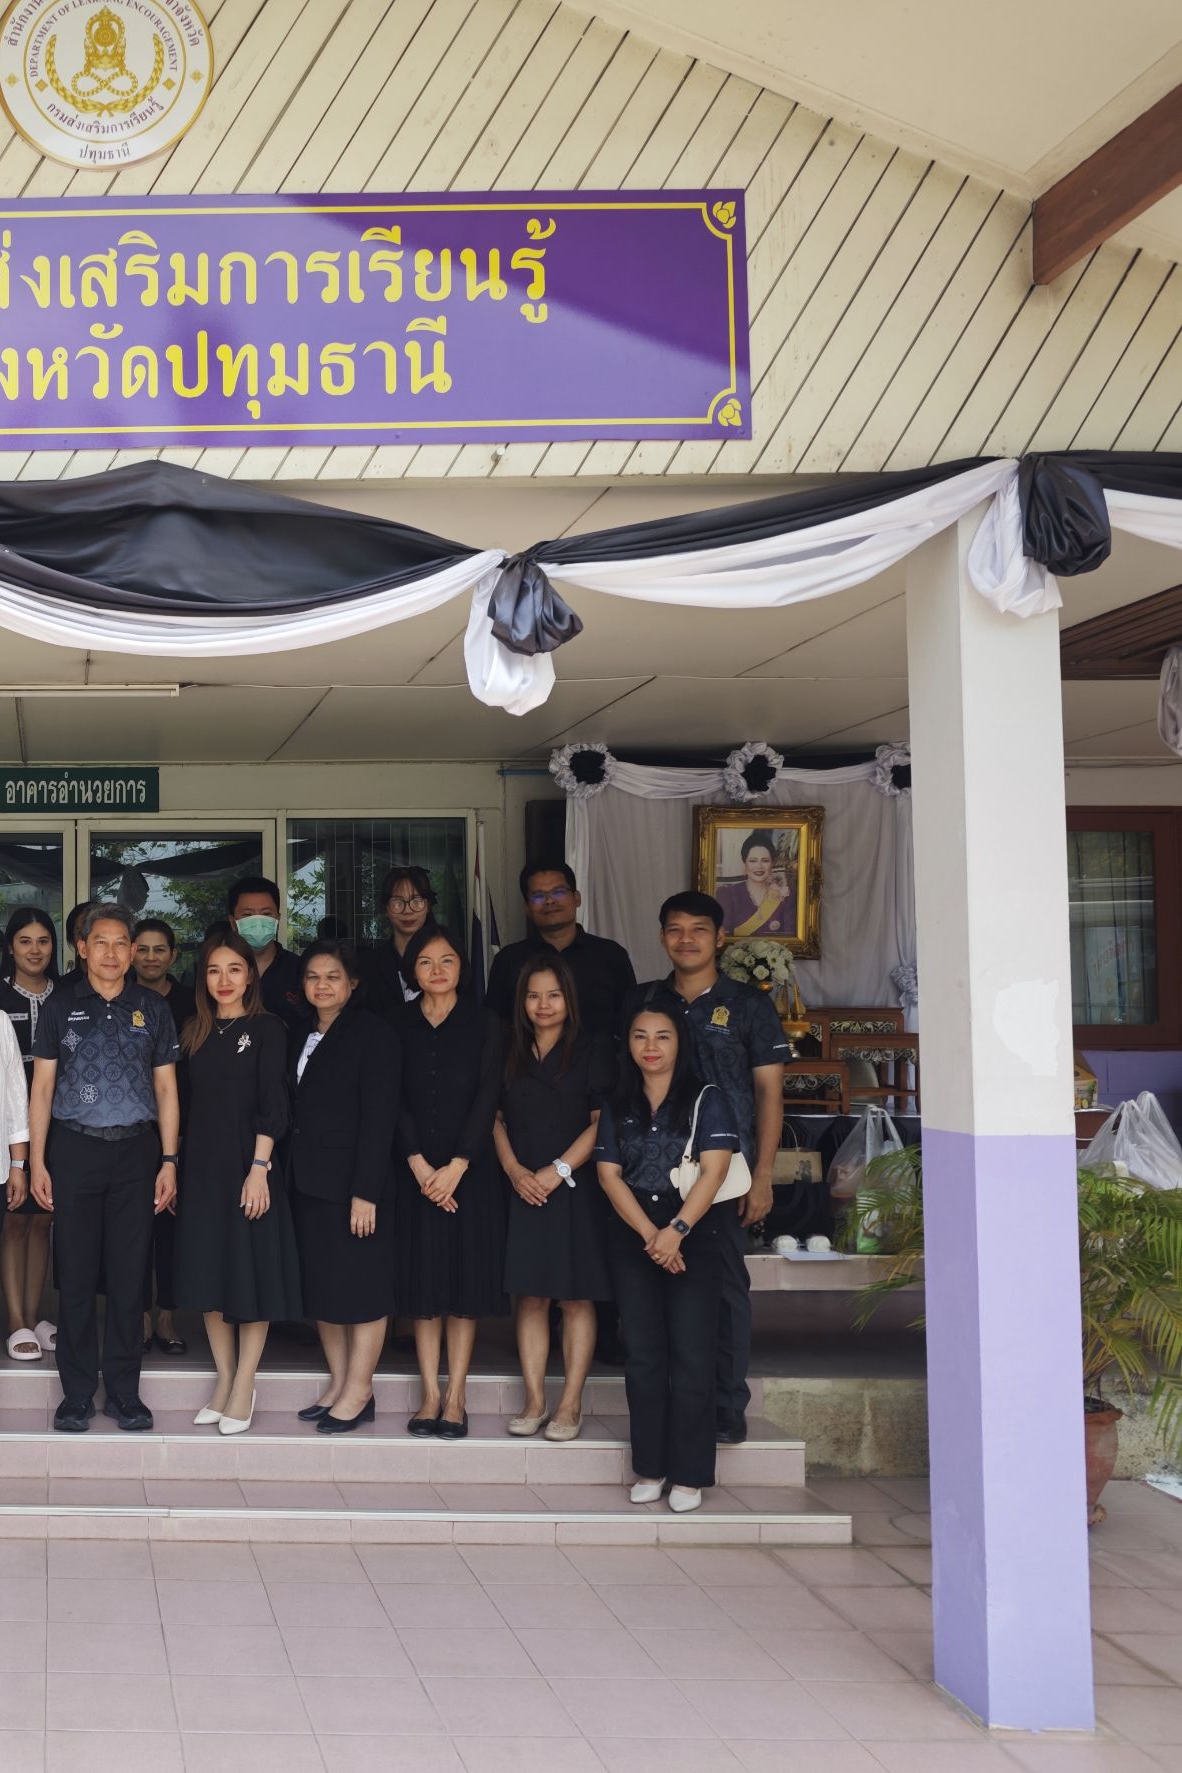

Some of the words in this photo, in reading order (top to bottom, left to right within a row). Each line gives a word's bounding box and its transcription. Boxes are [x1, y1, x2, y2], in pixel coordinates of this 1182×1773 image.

[29, 13, 58, 77] DEPARTMENT
[57, 5, 70, 16] OF
[47, 96, 165, 134] กรมส่งเสริมการเรียนรู้
[79, 142, 131, 164] ปทุมธานี
[4, 771, 146, 805] อาคารอำนวยการ
